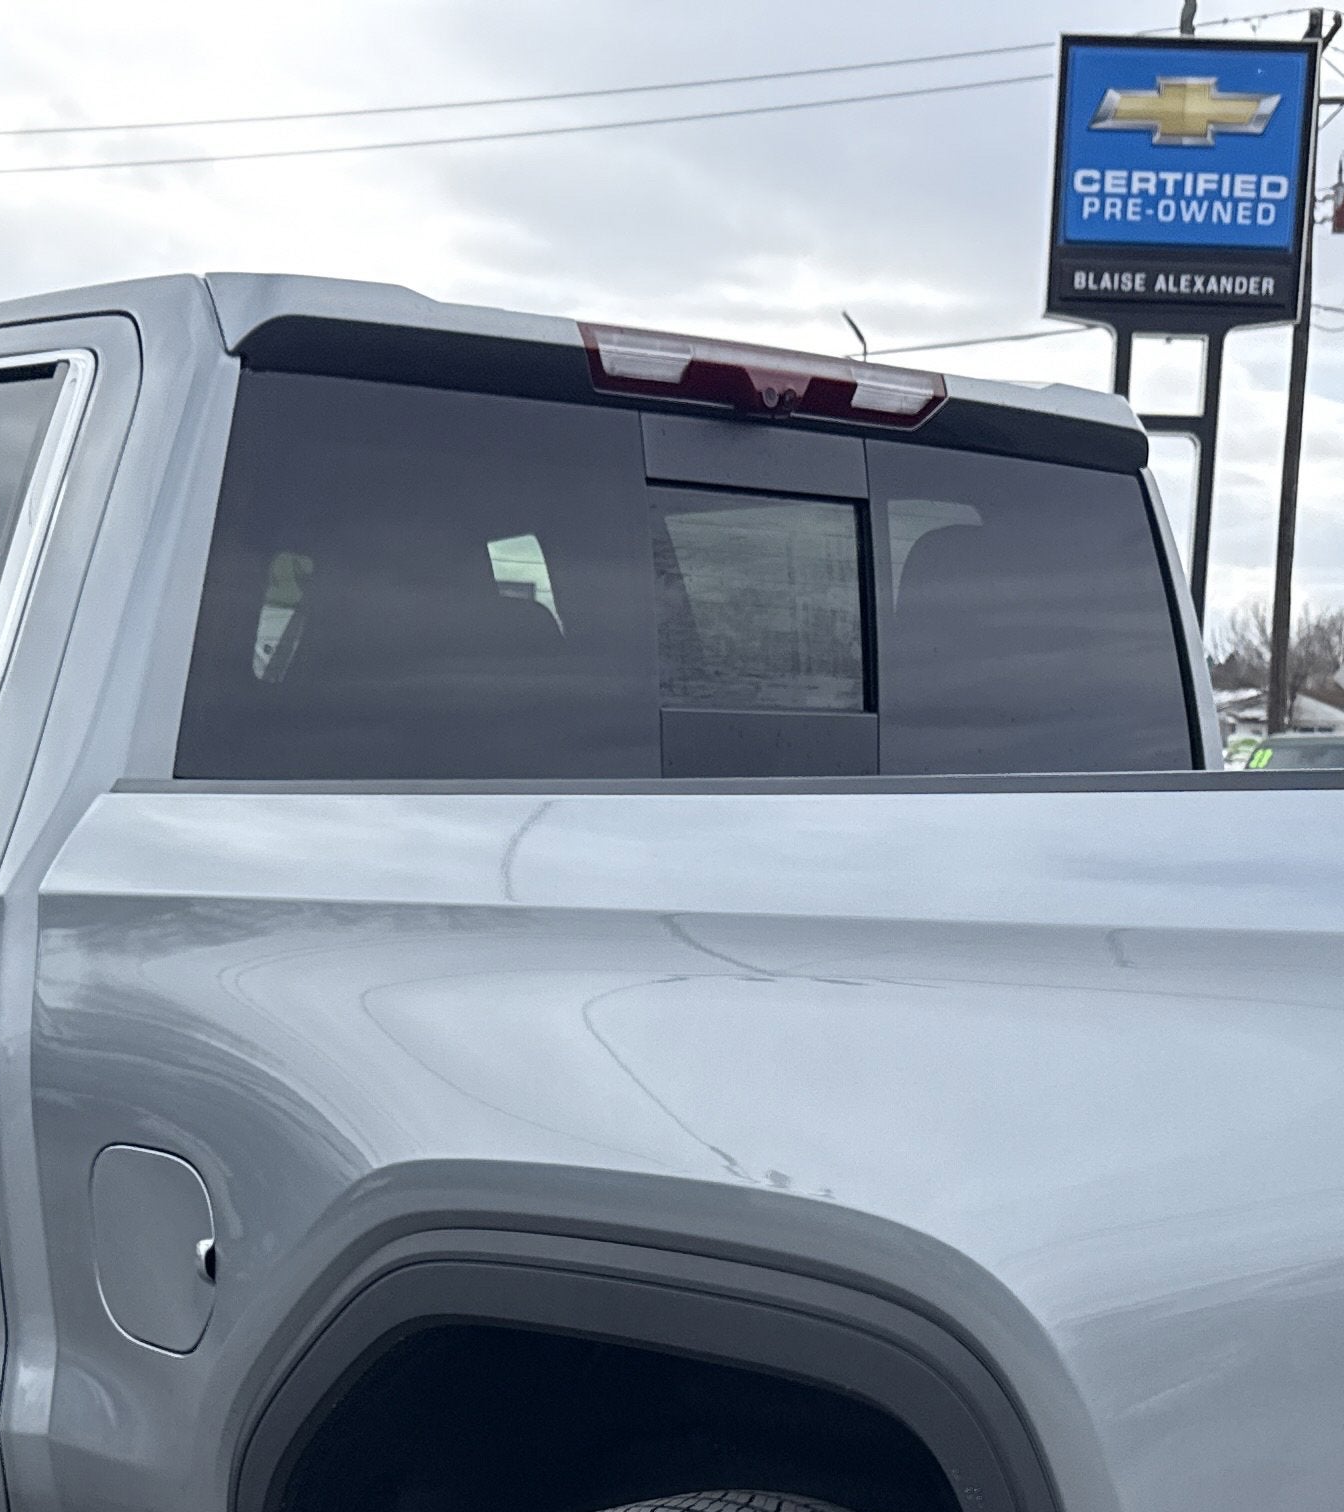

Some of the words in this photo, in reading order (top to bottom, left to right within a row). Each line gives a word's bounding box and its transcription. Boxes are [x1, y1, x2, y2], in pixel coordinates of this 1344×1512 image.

[1073, 168, 1289, 200] CERTIFIED
[1082, 197, 1277, 226] PRE-OWNED
[1073, 270, 1147, 292] BLAISE
[1154, 274, 1275, 296] ALEXANDER
